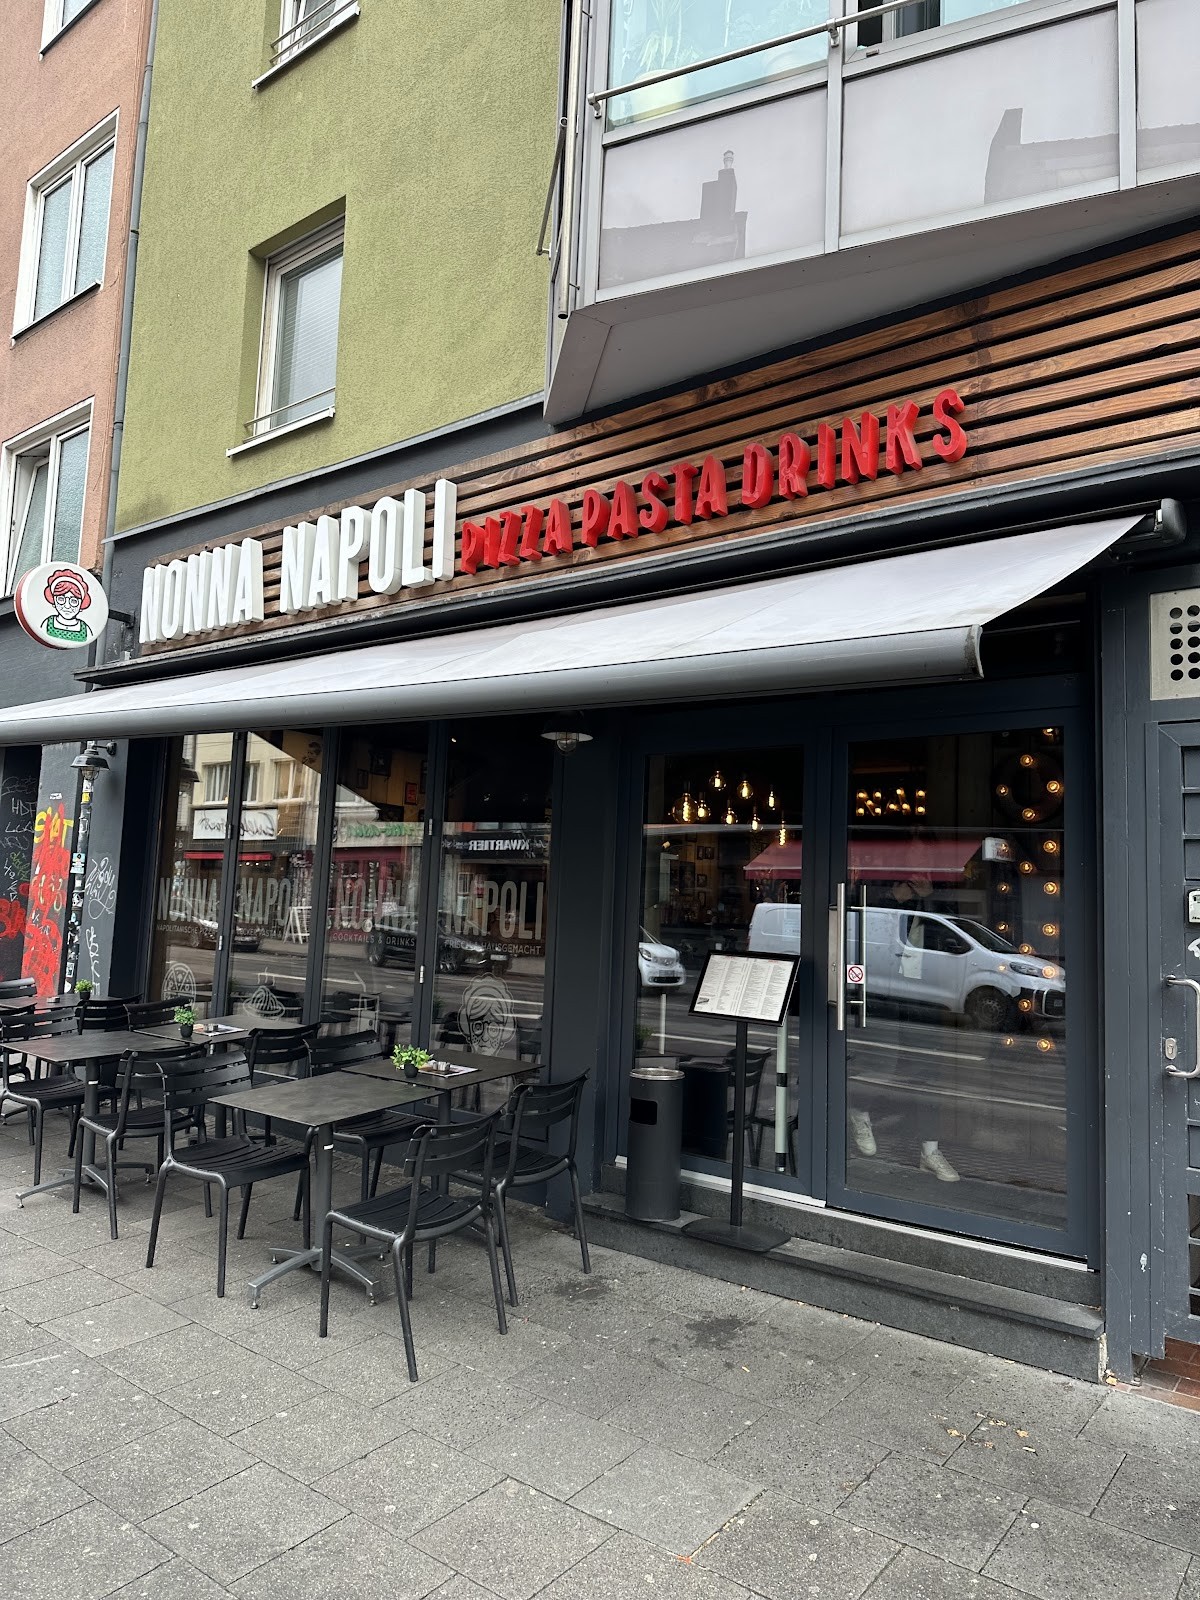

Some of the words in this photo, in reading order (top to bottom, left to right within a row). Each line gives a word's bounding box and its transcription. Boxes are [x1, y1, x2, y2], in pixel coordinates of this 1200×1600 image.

[460, 499, 573, 575] PIZZA
[581, 454, 728, 548] PASTA
[741, 388, 967, 510] DRINKS
[139, 538, 264, 645] NONNA
[279, 478, 457, 615] NAPOLI
[238, 877, 308, 926] NAPO
[445, 880, 544, 940] NAPOLI
[332, 932, 375, 944] COCKTAILS
[377, 936, 383, 944] &
[386, 936, 415, 947] DRINKS
[481, 942, 542, 954] HAUSGEMACHT
